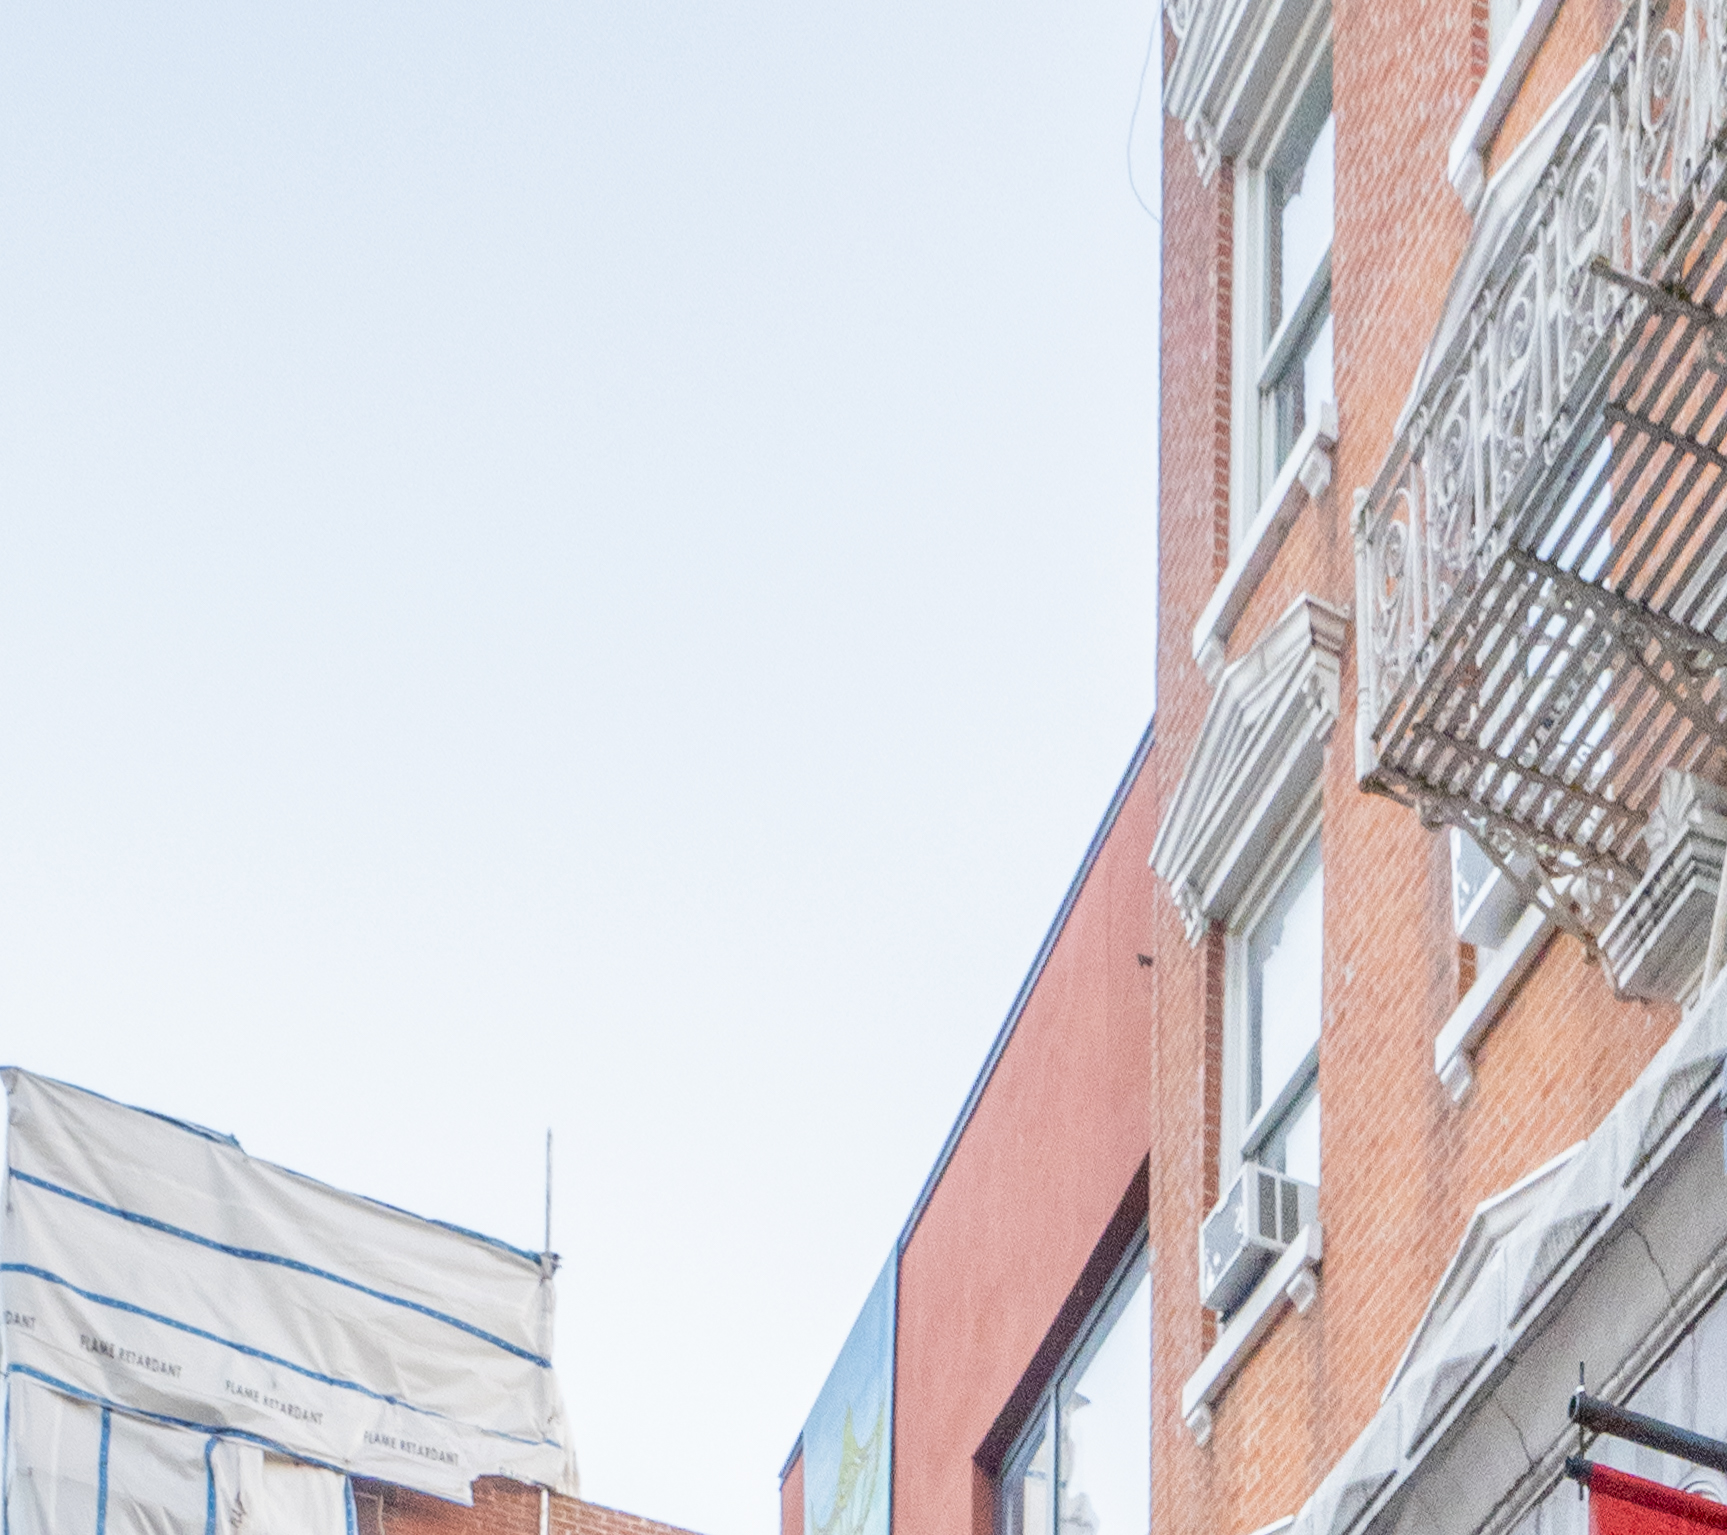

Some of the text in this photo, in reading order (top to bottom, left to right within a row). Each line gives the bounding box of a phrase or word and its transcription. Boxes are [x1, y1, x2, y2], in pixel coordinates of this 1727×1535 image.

[119, 1348, 182, 1378] RETARDANT
[225, 1380, 323, 1425] FLAME RETARDANT
[363, 1430, 459, 1467] FLAME RETARDANT
